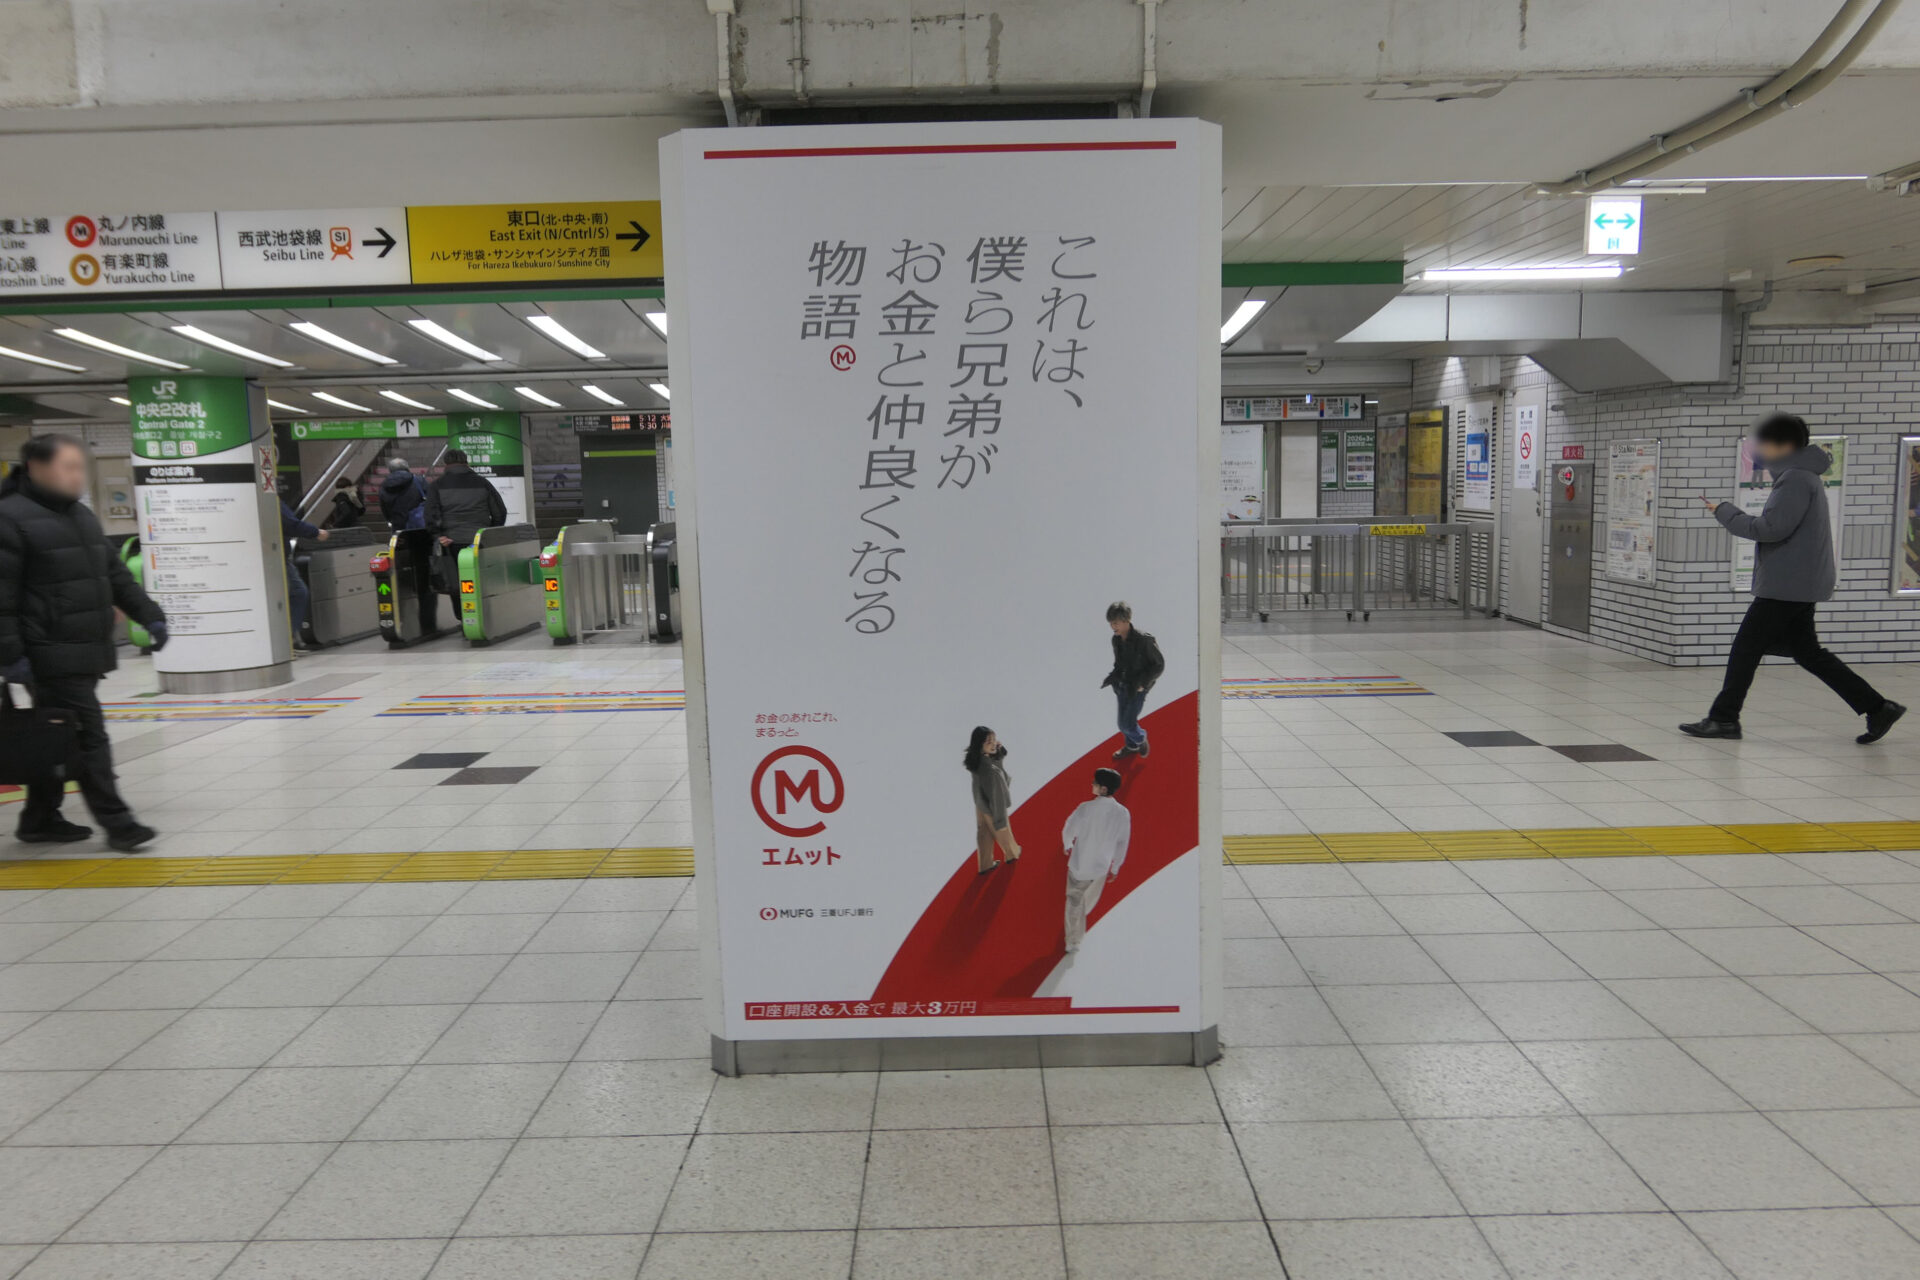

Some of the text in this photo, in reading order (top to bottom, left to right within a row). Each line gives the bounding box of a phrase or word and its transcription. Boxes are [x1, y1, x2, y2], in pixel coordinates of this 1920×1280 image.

[0, 218, 50, 234] 東上線
[98, 214, 165, 231] 丸ノ内線
[99, 232, 198, 246] Marunouchi Line
[238, 229, 323, 247] 西武池袋線
[334, 231, 346, 242] SI
[490, 226, 609, 241] East Exit (N/Cntrl/S)
[2, 237, 26, 249] Line
[262, 248, 325, 262] Seibu Line
[431, 246, 610, 261] ハレザ池袋・サンシャインシティ方面
[102, 252, 169, 270] 有楽町線
[468, 261, 480, 270] For
[482, 261, 510, 270] Hareza
[512, 259, 552, 269] Ikebukuro
[557, 258, 592, 268] Sunshine
[594, 258, 610, 268] City
[0, 274, 65, 287] toshin Line
[103, 271, 195, 284] Yurakucho Line
[800, 239, 867, 340] 物語
[1031, 235, 1097, 408] これは、
[937, 235, 1028, 490] 僕ら兄弟が
[152, 380, 177, 395] JR
[136, 401, 207, 418] 中央2改札
[138, 419, 205, 429] Central Gate 2
[465, 418, 481, 427] JR
[639, 422, 657, 430] 5:30
[845, 238, 946, 634] お金と仲良くなる
[461, 581, 475, 594] IC
[545, 579, 559, 591] IC
[755, 712, 838, 724] お金のあれこれ、
[756, 727, 800, 737] まるっと。
[762, 846, 842, 866] エムット
[780, 908, 814, 918] MUFG
[749, 1002, 885, 1017] 口座開設&入金で
[891, 1000, 977, 1015] 最大3万円
